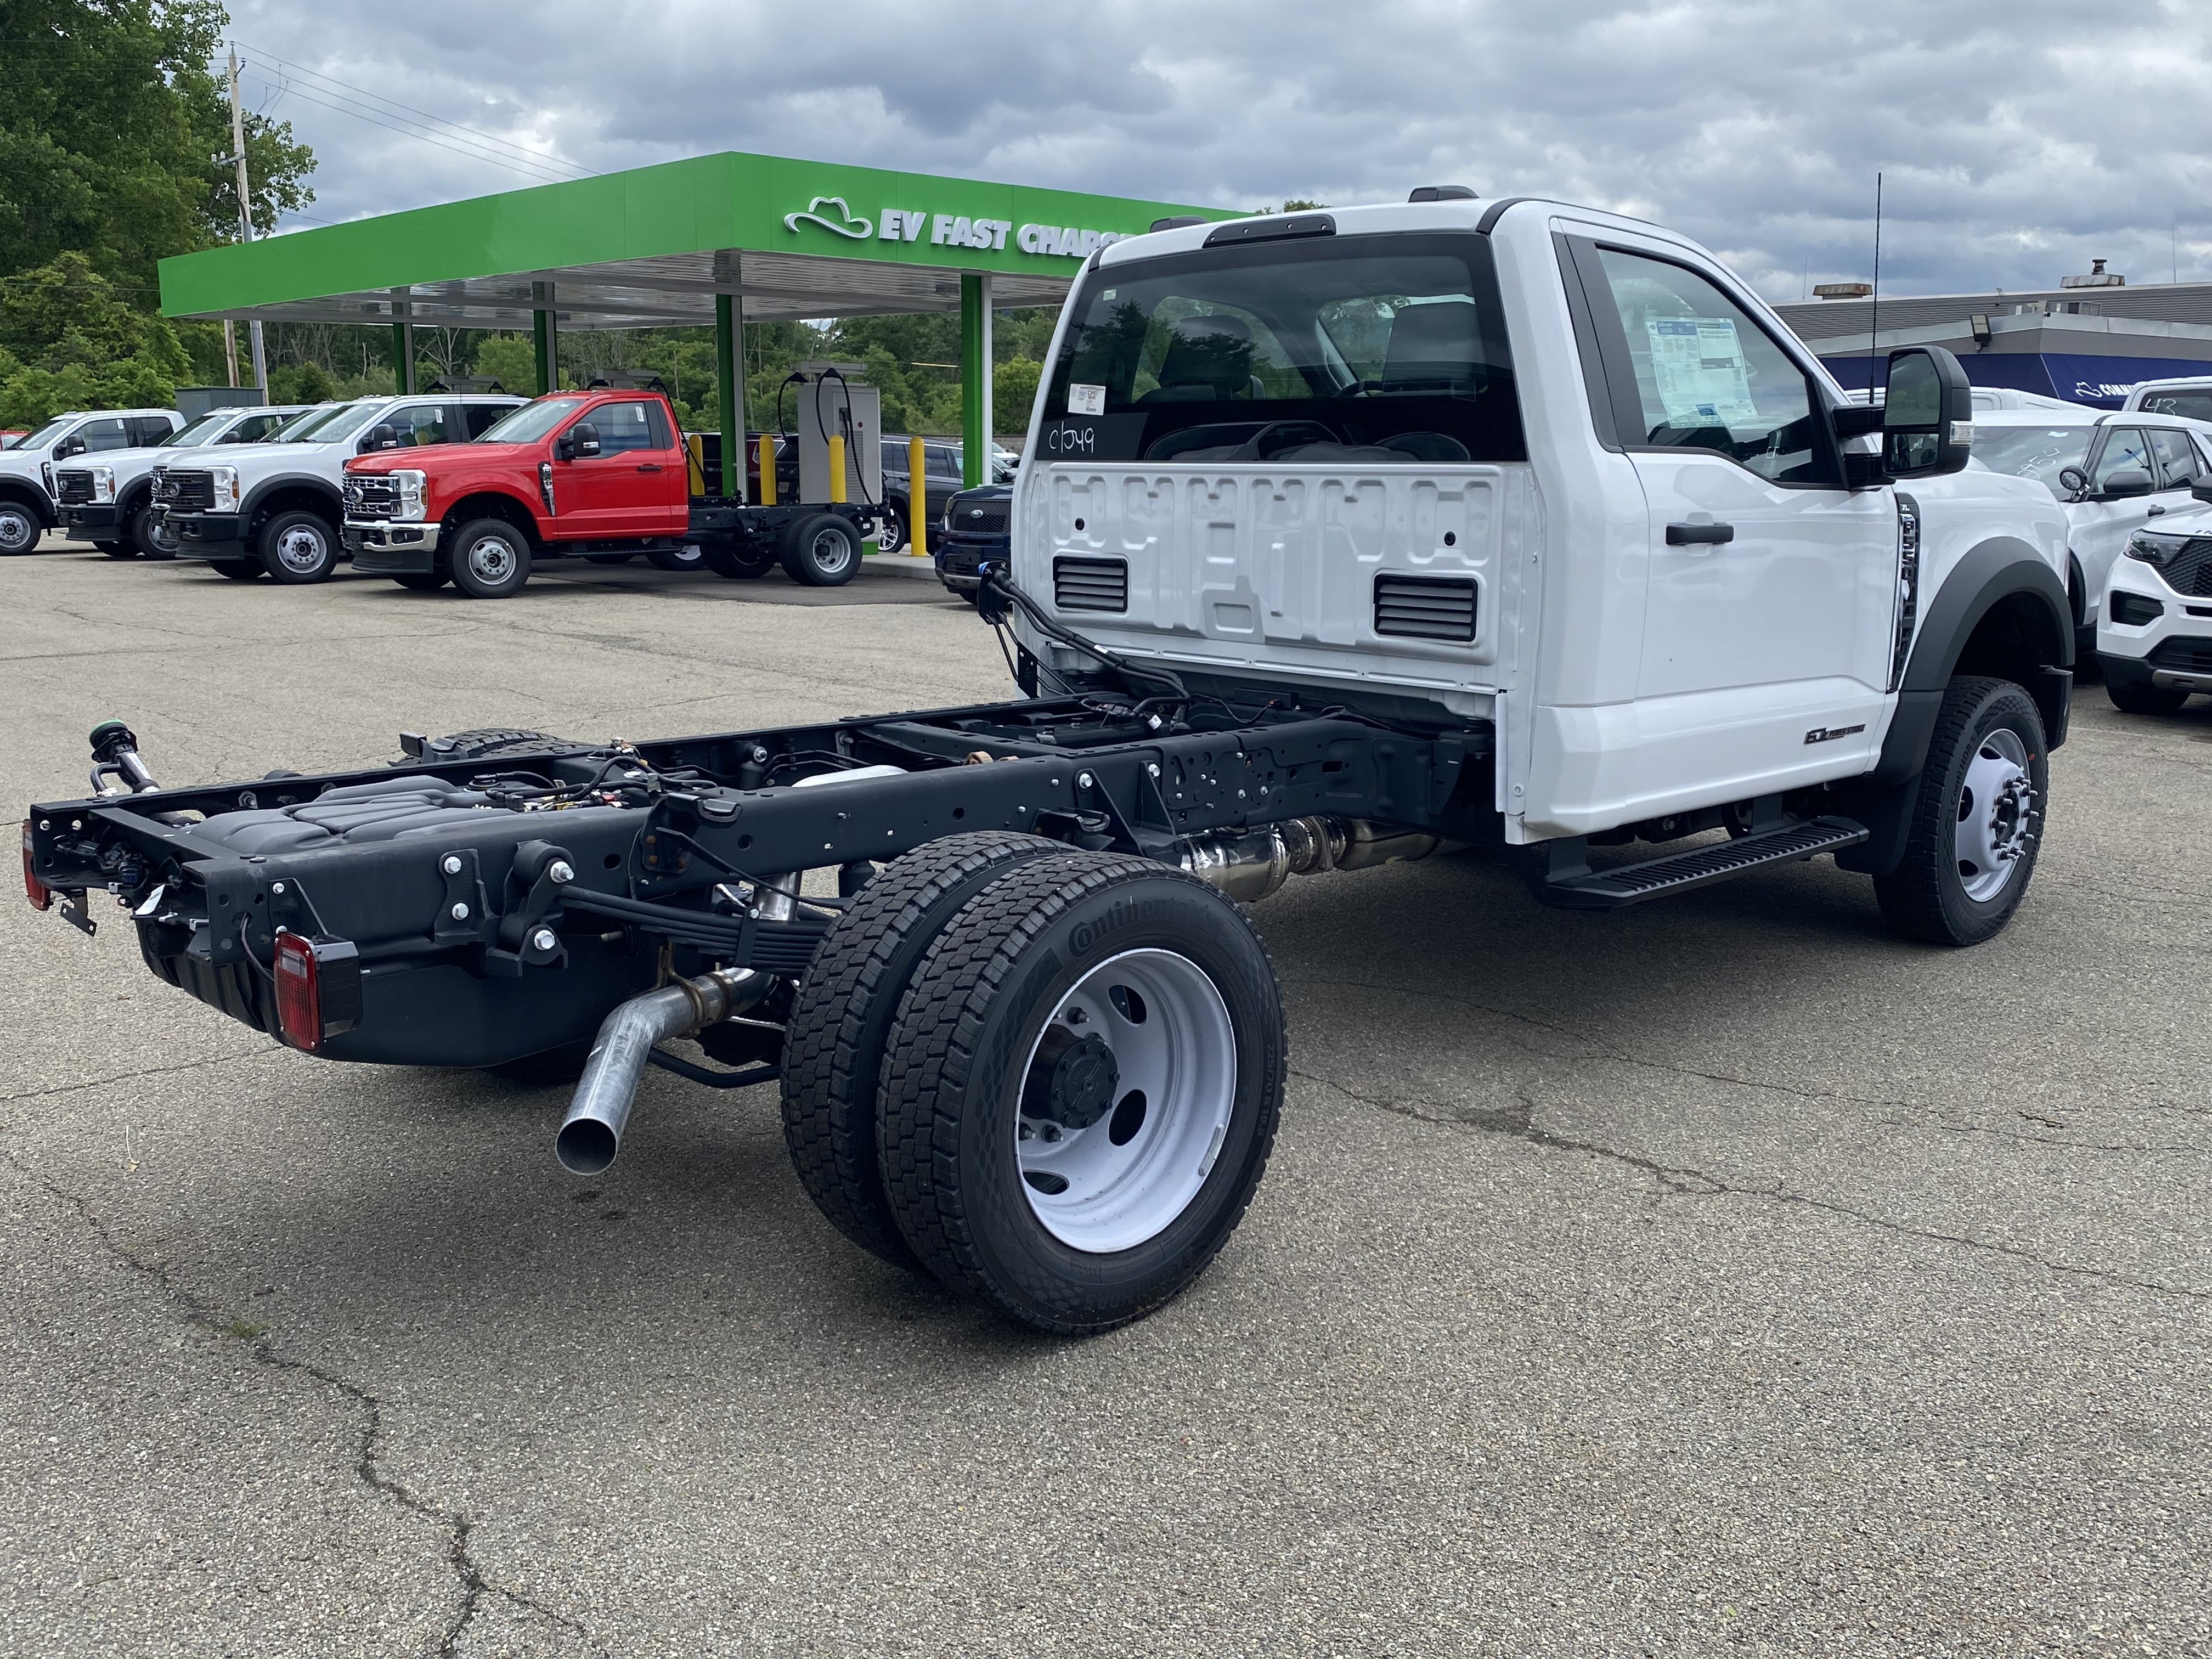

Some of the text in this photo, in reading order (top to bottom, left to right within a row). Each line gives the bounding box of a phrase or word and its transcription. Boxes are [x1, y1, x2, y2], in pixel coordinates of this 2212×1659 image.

[878, 208, 1138, 258] EV FAST CHAR
